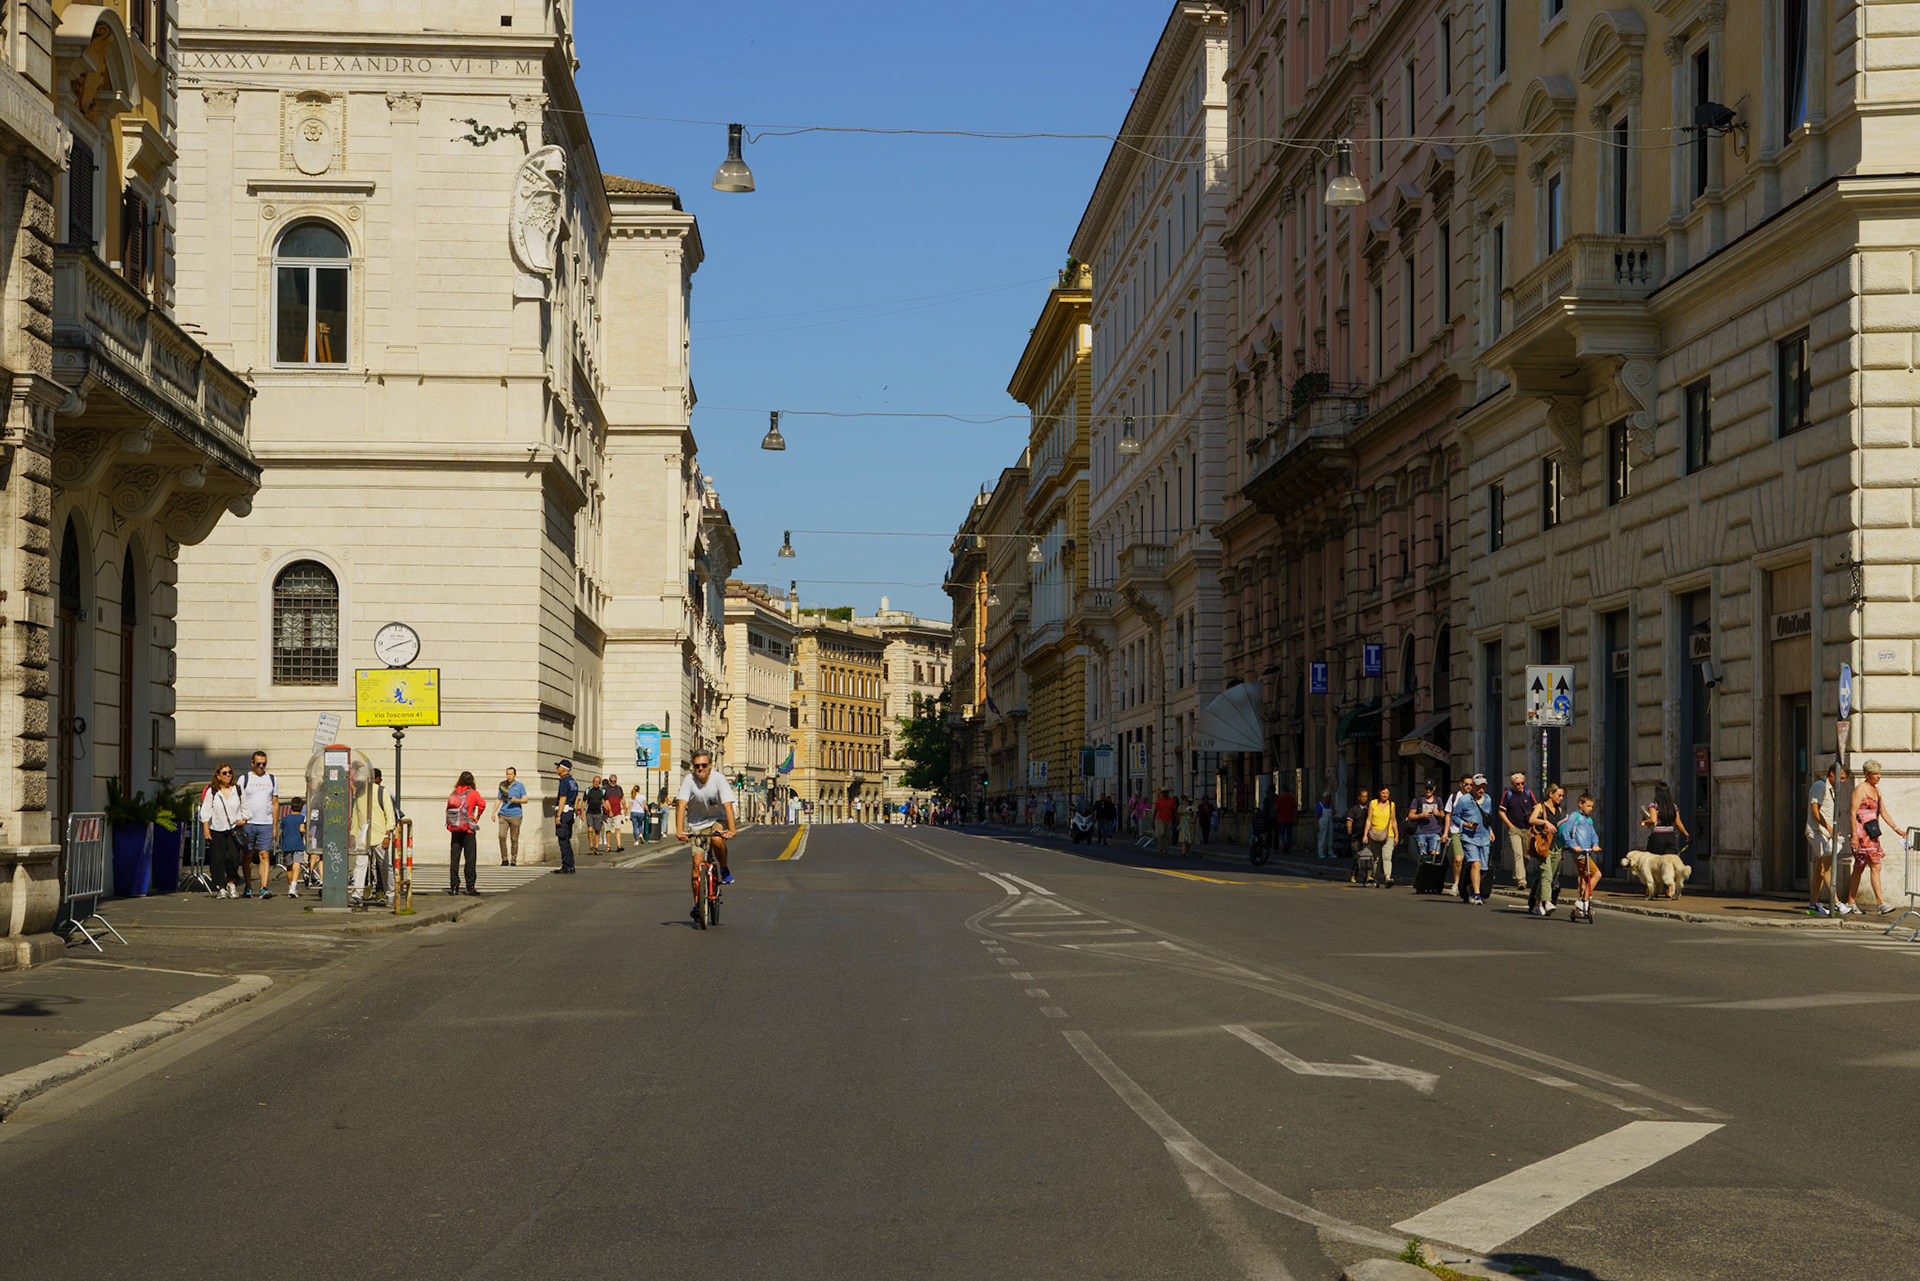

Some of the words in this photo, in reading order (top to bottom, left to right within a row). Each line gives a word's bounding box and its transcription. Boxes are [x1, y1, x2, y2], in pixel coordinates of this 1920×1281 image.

[181, 53, 270, 69] LXXXXV
[289, 55, 432, 73] ALEXANDRO
[449, 59, 471, 73] VI
[490, 60, 499, 74] P
[515, 61, 531, 75] M
[1366, 645, 1380, 665] T
[1313, 664, 1326, 682] T
